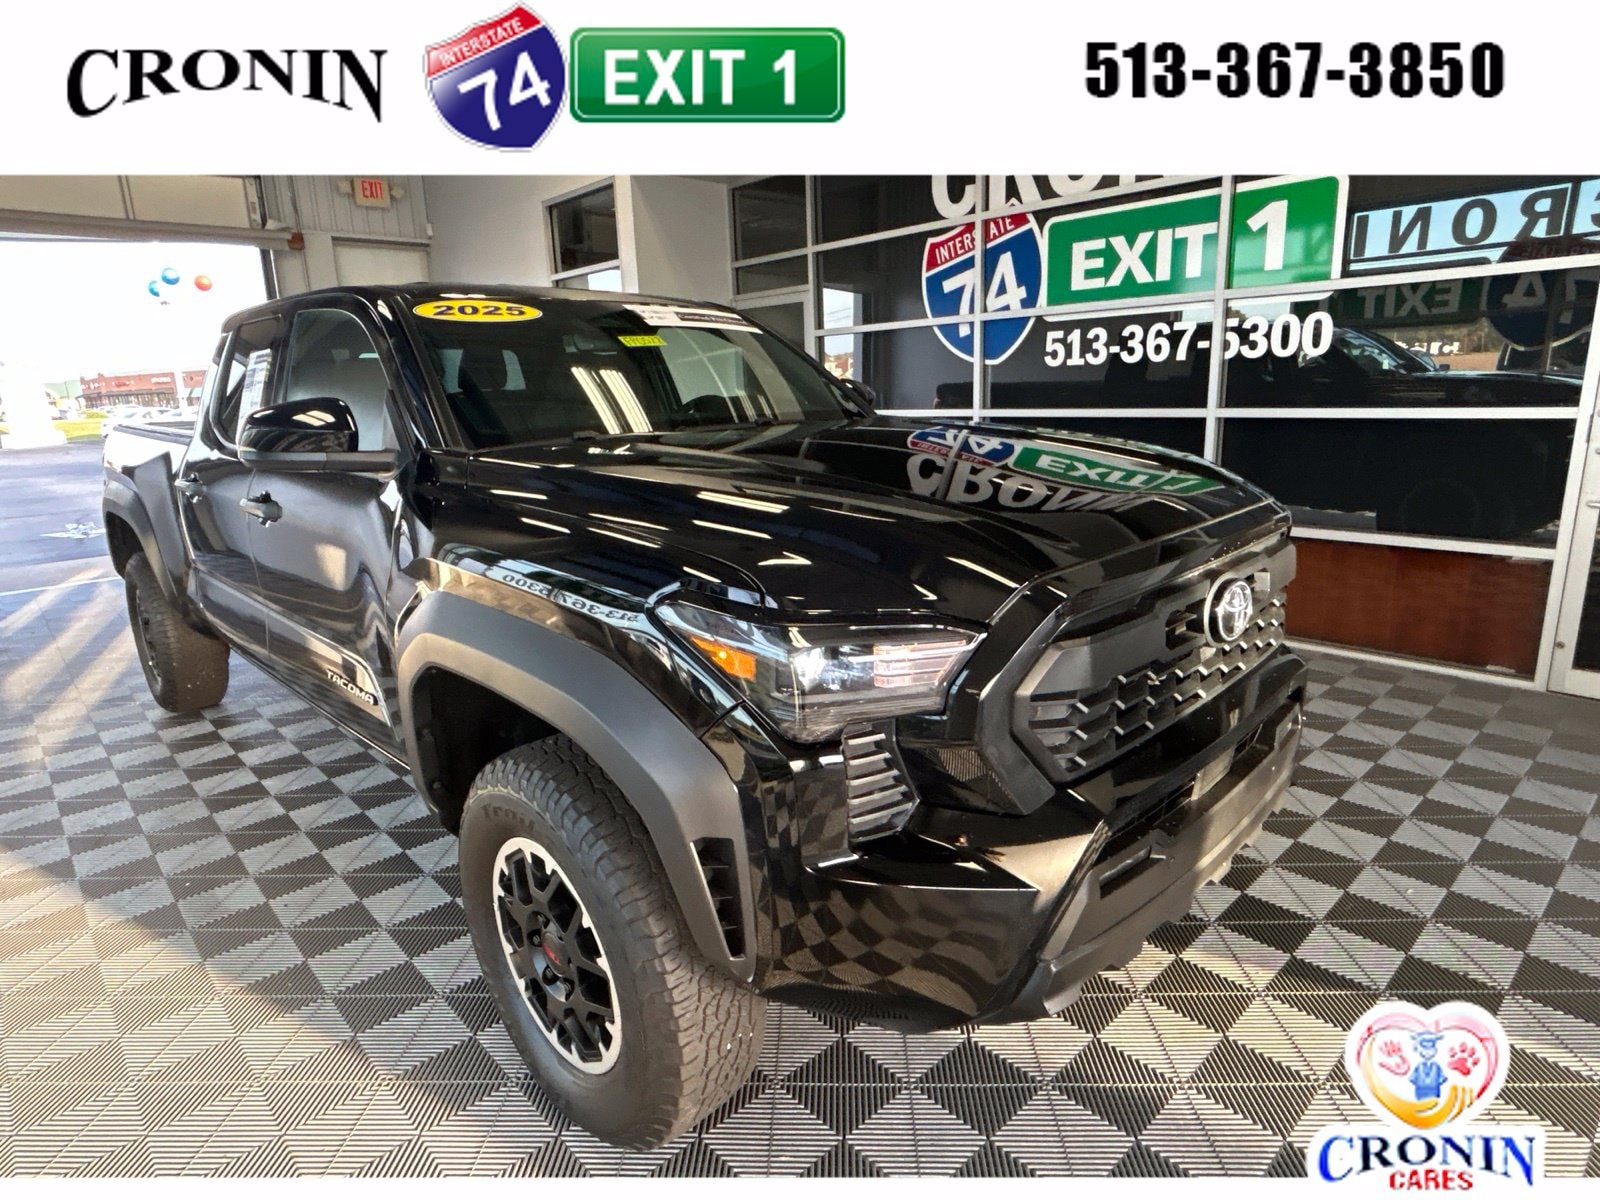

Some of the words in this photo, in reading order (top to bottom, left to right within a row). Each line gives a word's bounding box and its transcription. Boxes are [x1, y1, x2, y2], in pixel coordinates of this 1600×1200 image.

[361, 180, 385, 199] EXIT
[1071, 222, 1218, 291] EXIT
[1246, 200, 1288, 271] 1
[433, 305, 526, 316] 2025
[942, 251, 1028, 337] 74
[1044, 311, 1333, 367] 513-367-5300
[326, 670, 376, 705] TACOMA
